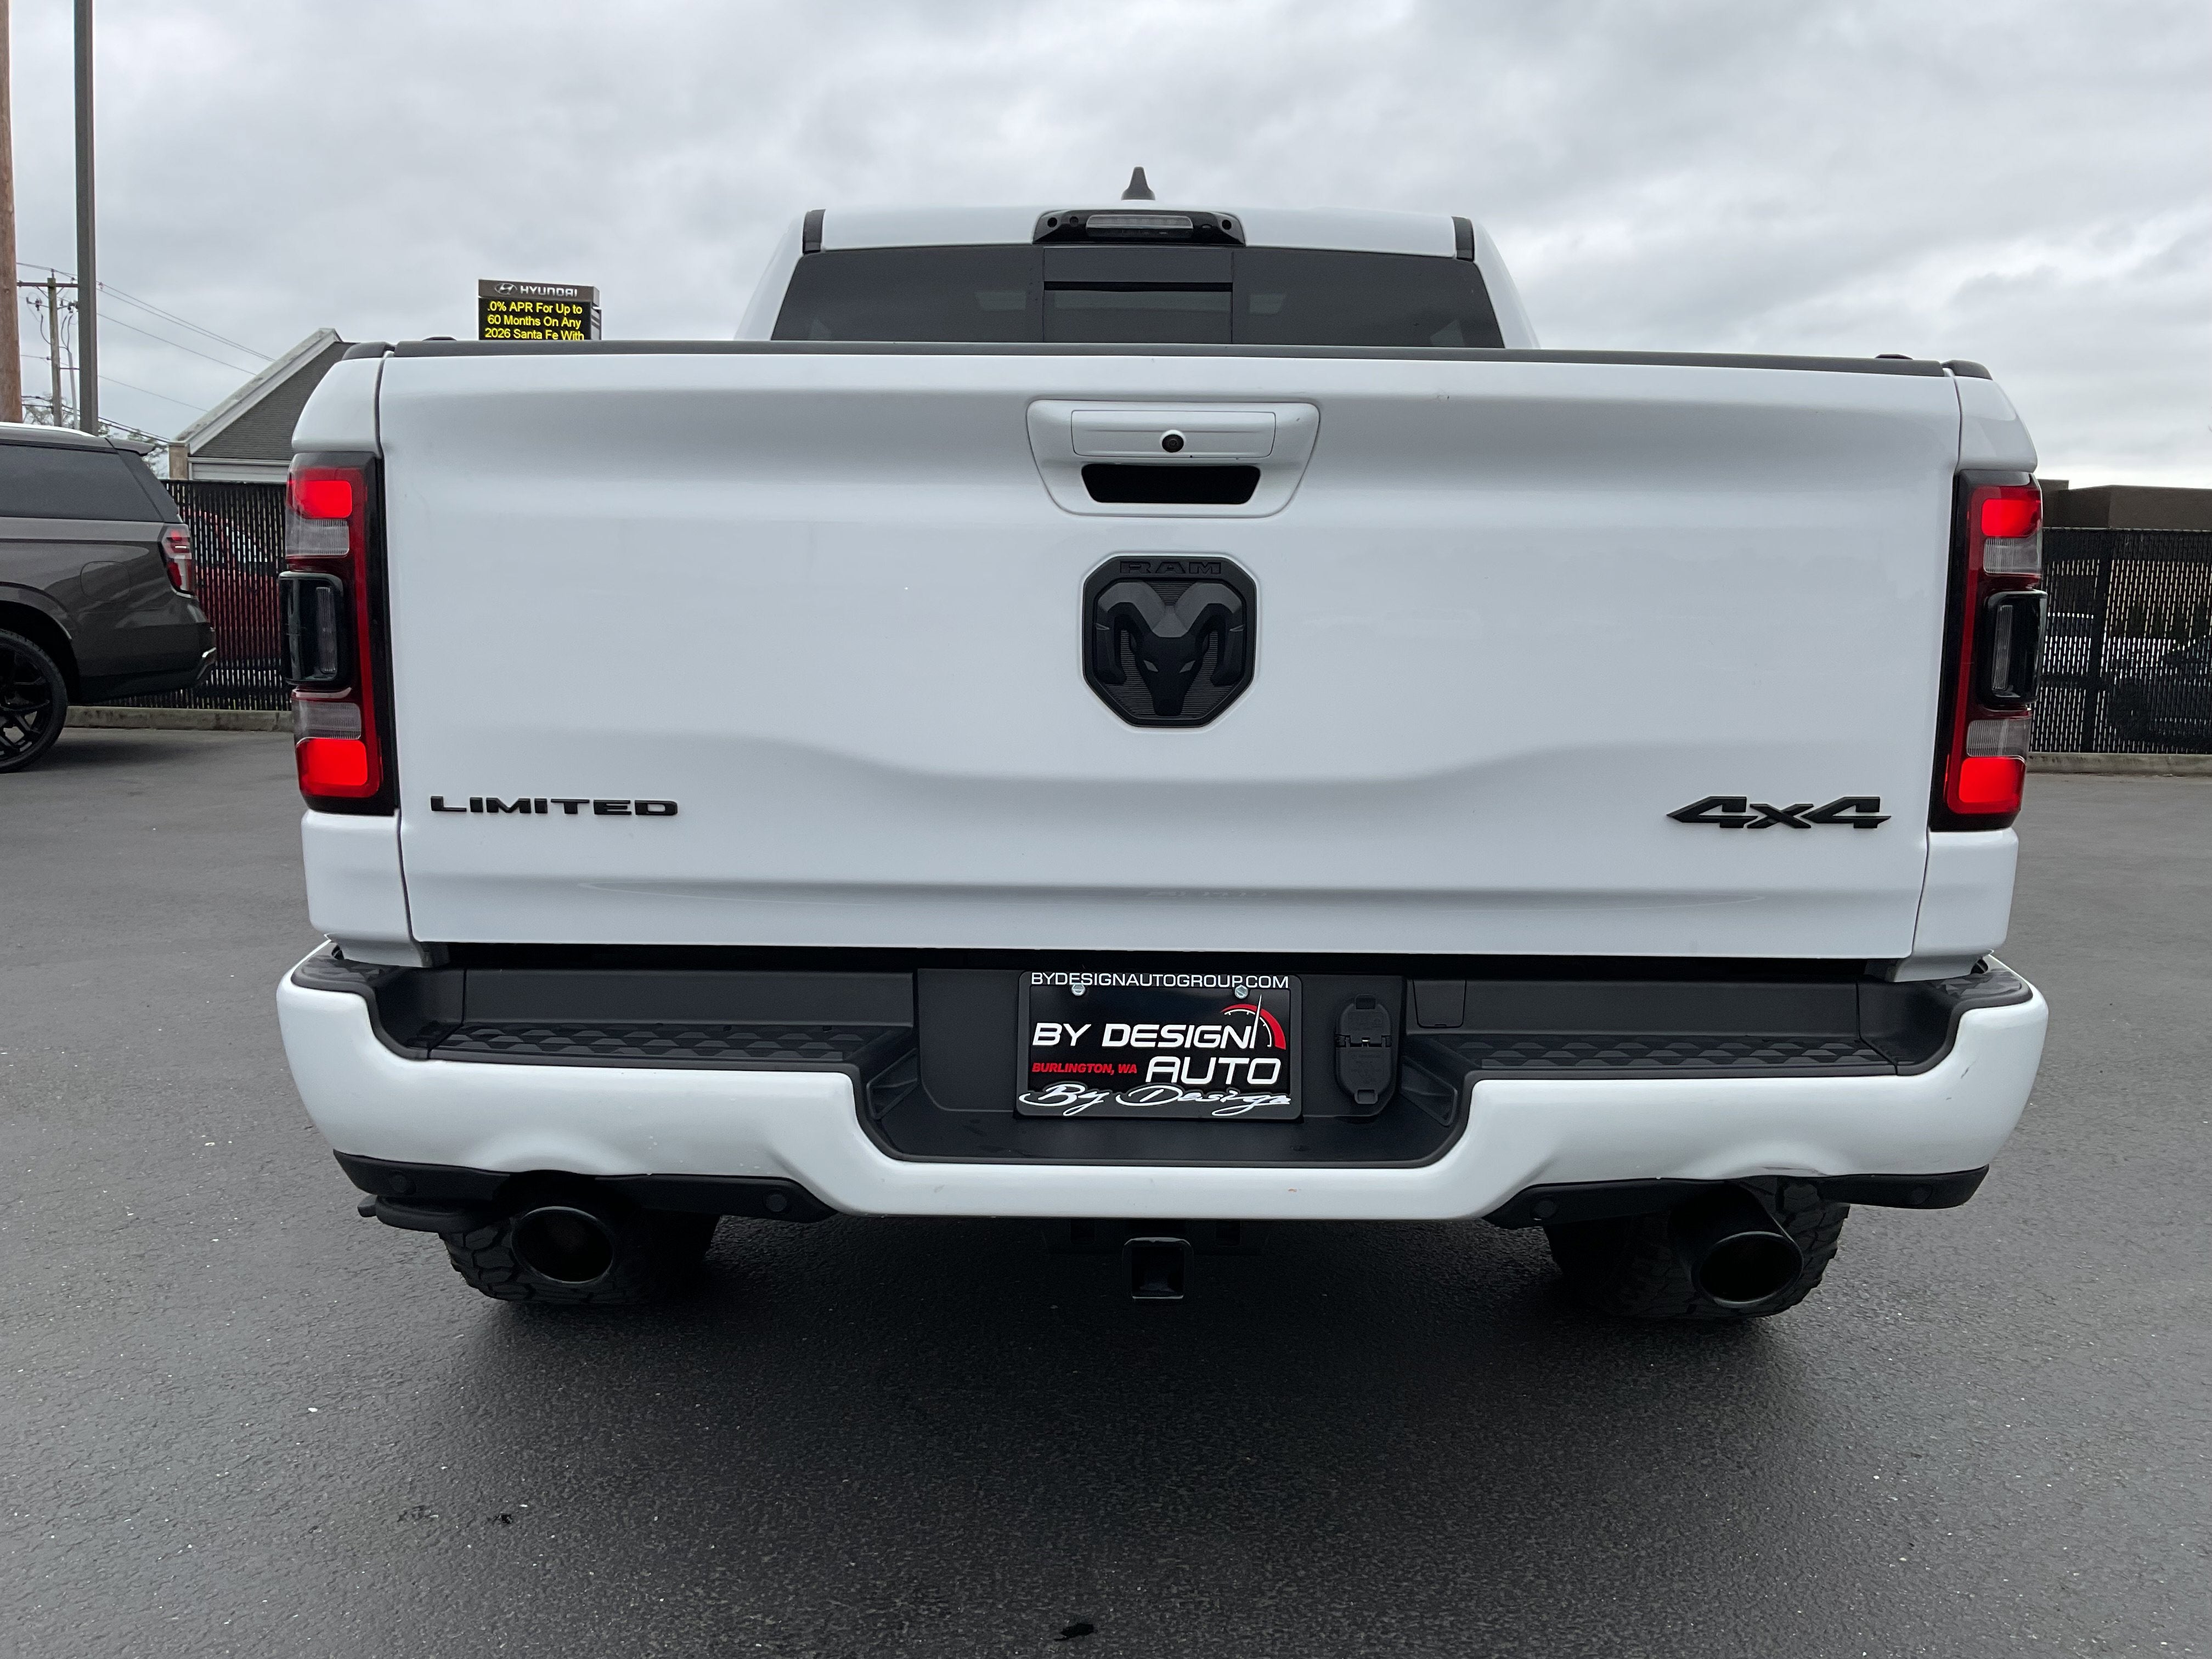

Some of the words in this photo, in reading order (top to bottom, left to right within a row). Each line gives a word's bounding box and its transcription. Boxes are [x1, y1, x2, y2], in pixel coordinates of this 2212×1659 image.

[521, 285, 578, 297] HYUNDAI
[509, 301, 533, 313] APR
[536, 302, 553, 313] For
[556, 303, 571, 316] Up
[572, 304, 583, 314] to
[487, 314, 501, 325] 60
[504, 314, 541, 326] Months
[543, 316, 558, 327] On
[561, 317, 582, 330] Any
[484, 328, 511, 338] 2026
[513, 329, 543, 340] Santa
[545, 330, 558, 340] Fe
[560, 330, 585, 340] With
[1120, 561, 1222, 574] RAM
[431, 795, 678, 816] LIMITED
[1031, 972, 1289, 989] BYDESIGNAUTOGROUP.COM
[1032, 1023, 1091, 1047] BY
[1102, 1023, 1256, 1049] DESIGN
[1031, 1062, 1115, 1076] BURLINGTON,
[1118, 1064, 1137, 1074] WA
[1145, 1056, 1282, 1085] AUTO
[1018, 1084, 1110, 1117] By
[1115, 1085, 1291, 1117] Design
